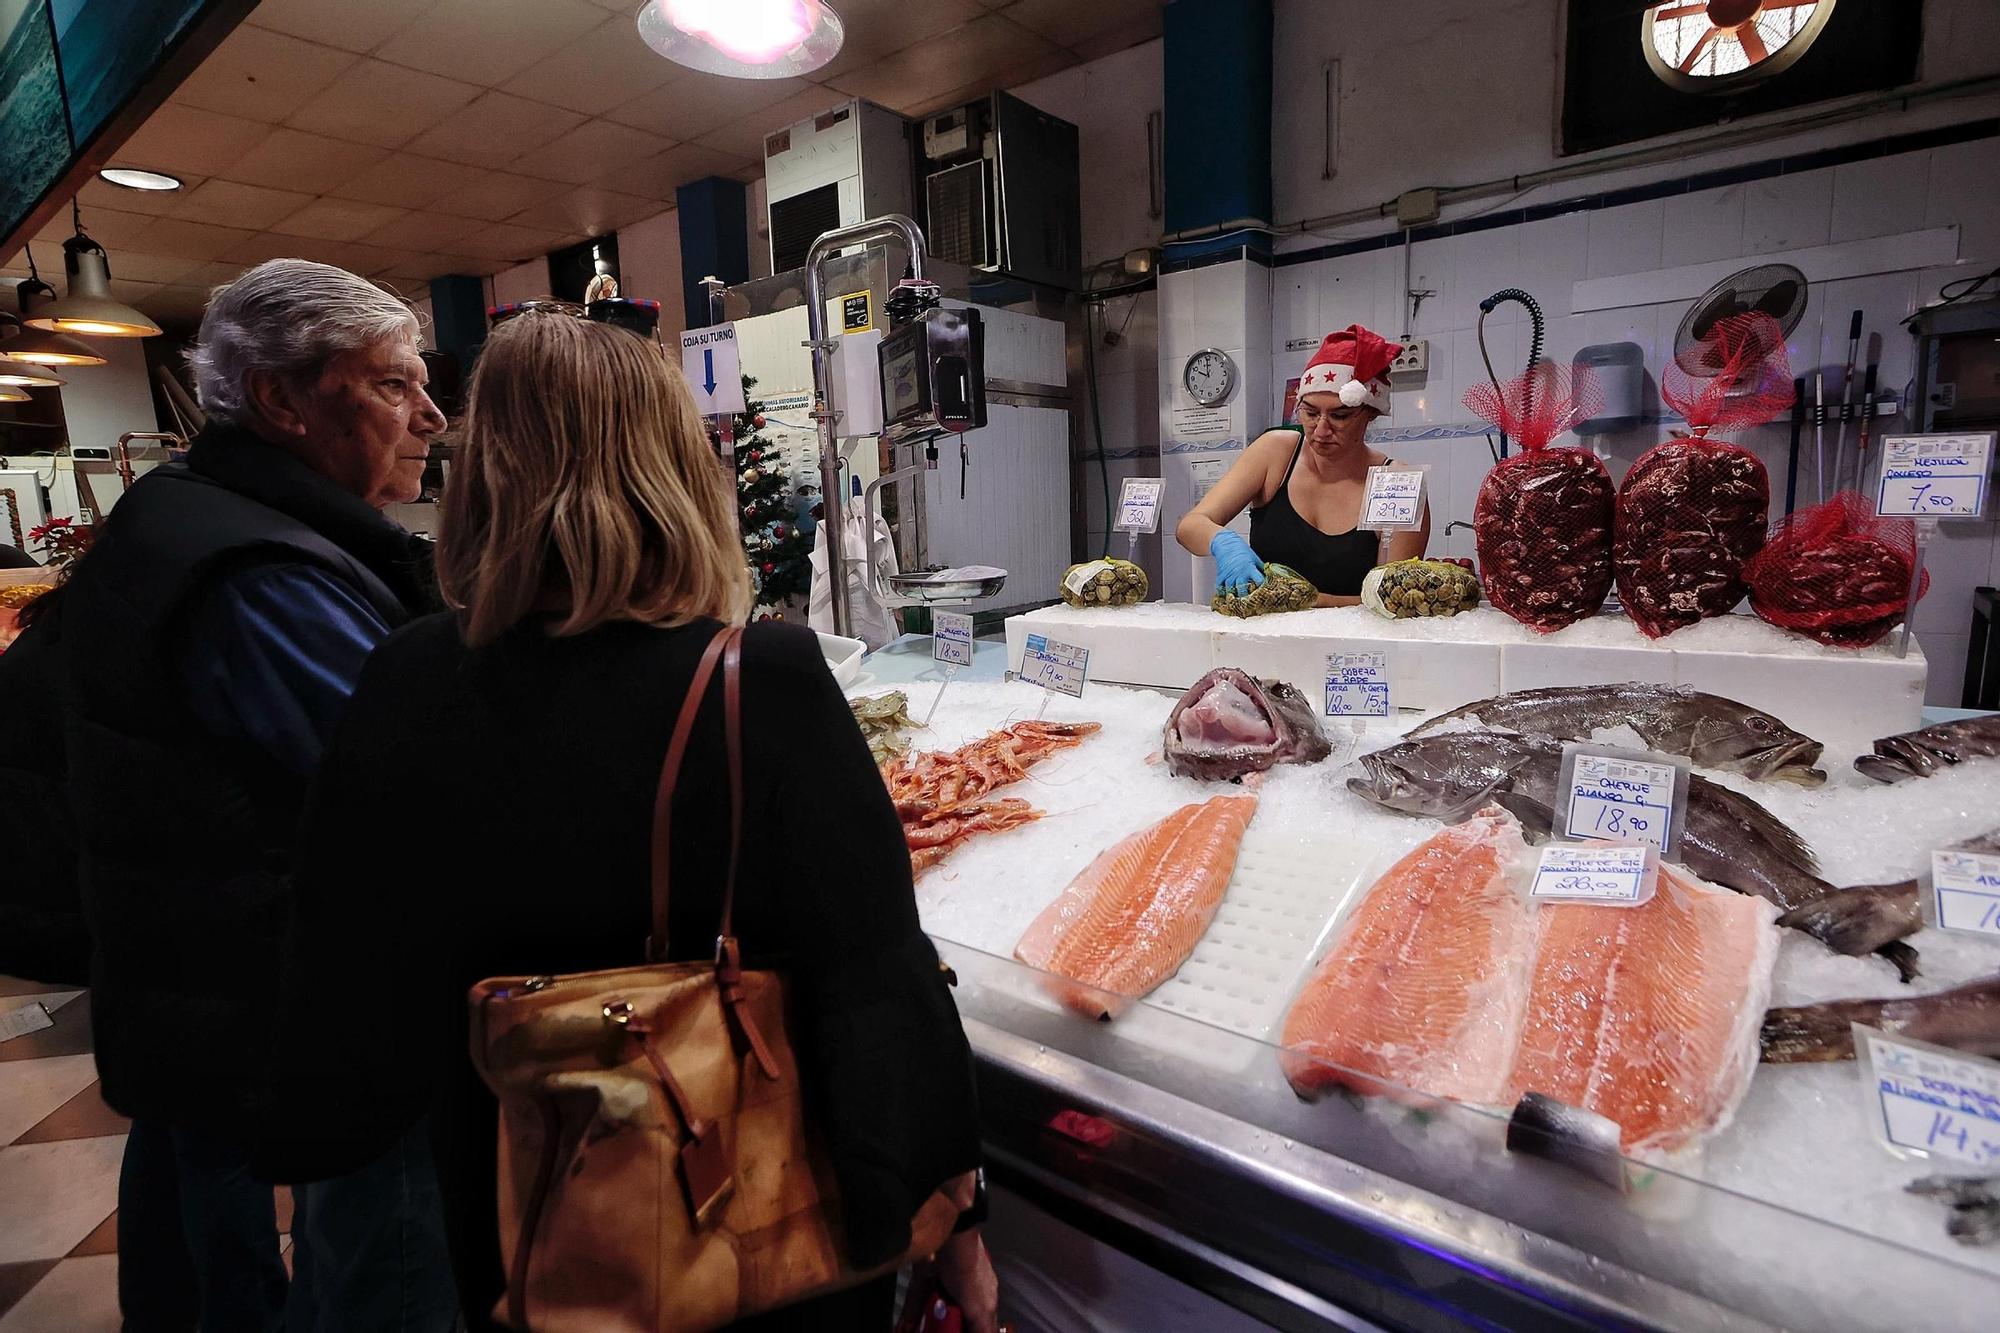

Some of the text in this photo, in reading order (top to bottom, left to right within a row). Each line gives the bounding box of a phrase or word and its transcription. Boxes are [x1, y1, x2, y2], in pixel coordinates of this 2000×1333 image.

[683, 328, 733, 347] COJA SU TURNO
[1908, 484, 1954, 512] 7,50
[1341, 667, 1377, 676] CABEZA
[1342, 675, 1369, 685] RAPE
[1600, 778, 1650, 793] CHERNE
[1594, 805, 1648, 837] 18,90
